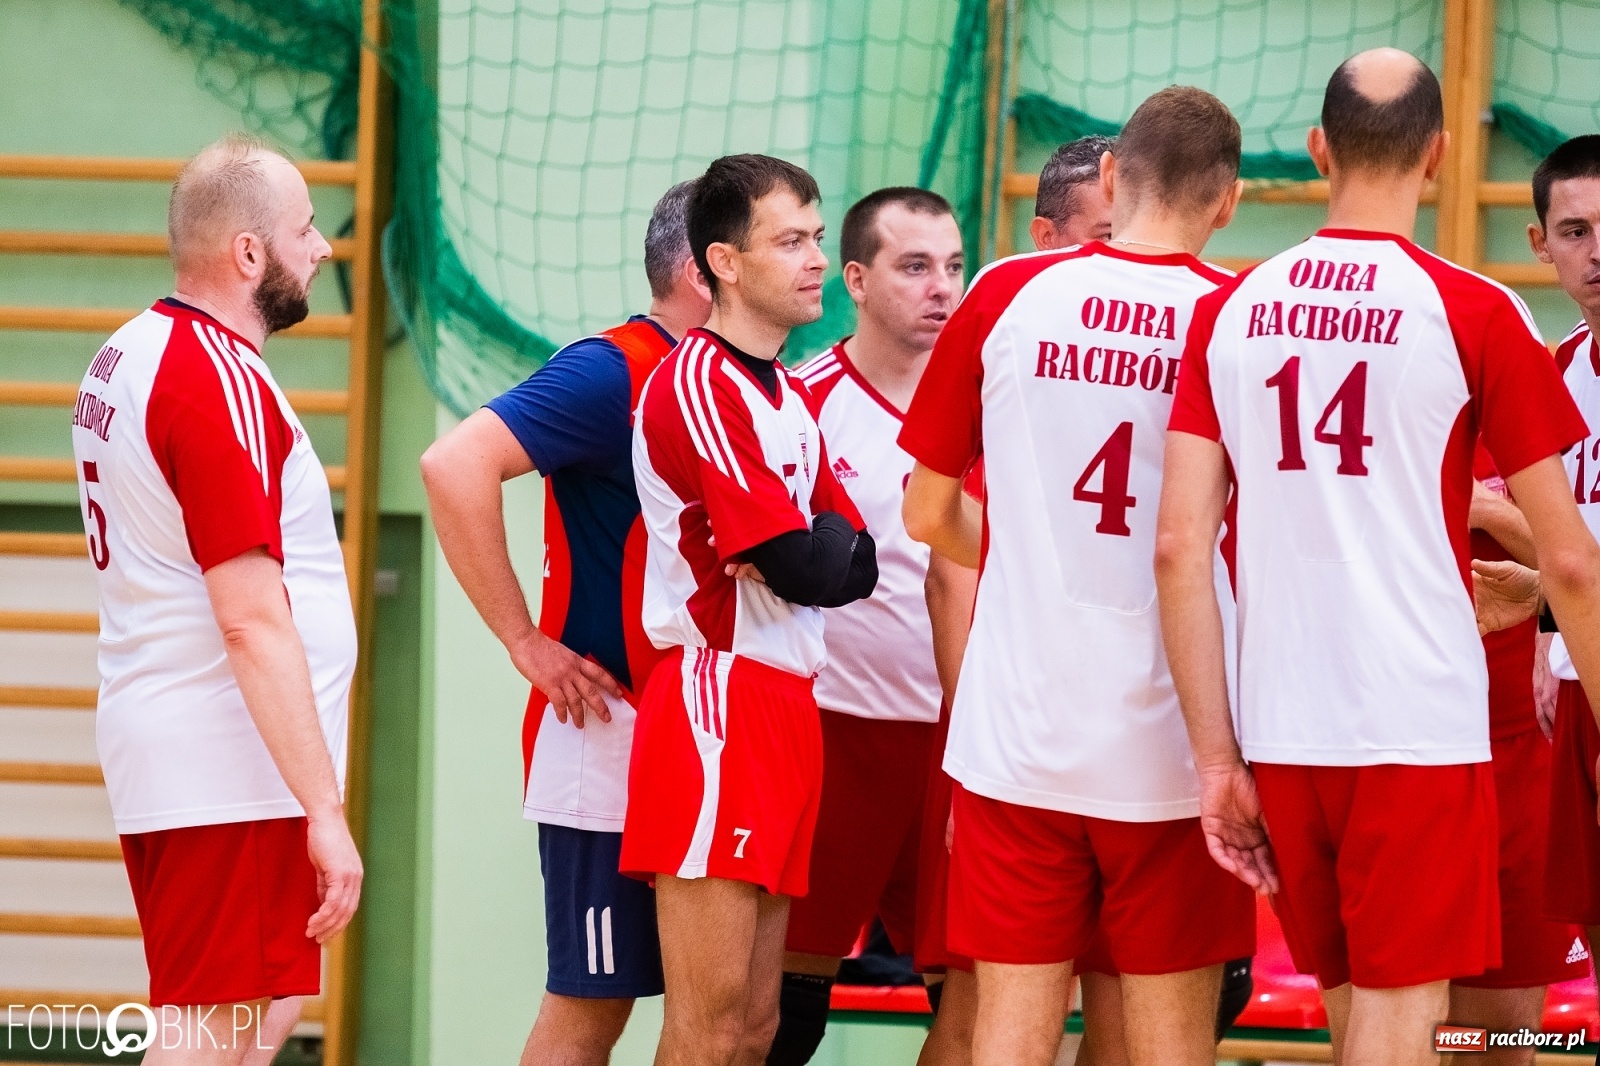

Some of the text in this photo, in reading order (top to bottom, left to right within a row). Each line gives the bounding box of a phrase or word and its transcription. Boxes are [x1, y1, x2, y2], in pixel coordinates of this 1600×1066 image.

[1289, 258, 1377, 292] ODRA
[1081, 296, 1176, 340] ODRA
[1246, 300, 1403, 345] RACIBÓRZ
[89, 345, 123, 384] ODRA
[1034, 341, 1181, 395] RACIBÓR
[73, 391, 116, 443] ACIBÓRZ
[1265, 355, 1373, 476] 14
[1073, 421, 1136, 536] 4
[83, 460, 110, 571] 5
[733, 827, 752, 859] 7
[586, 906, 615, 975] 11
[1565, 950, 1589, 964] adidas
